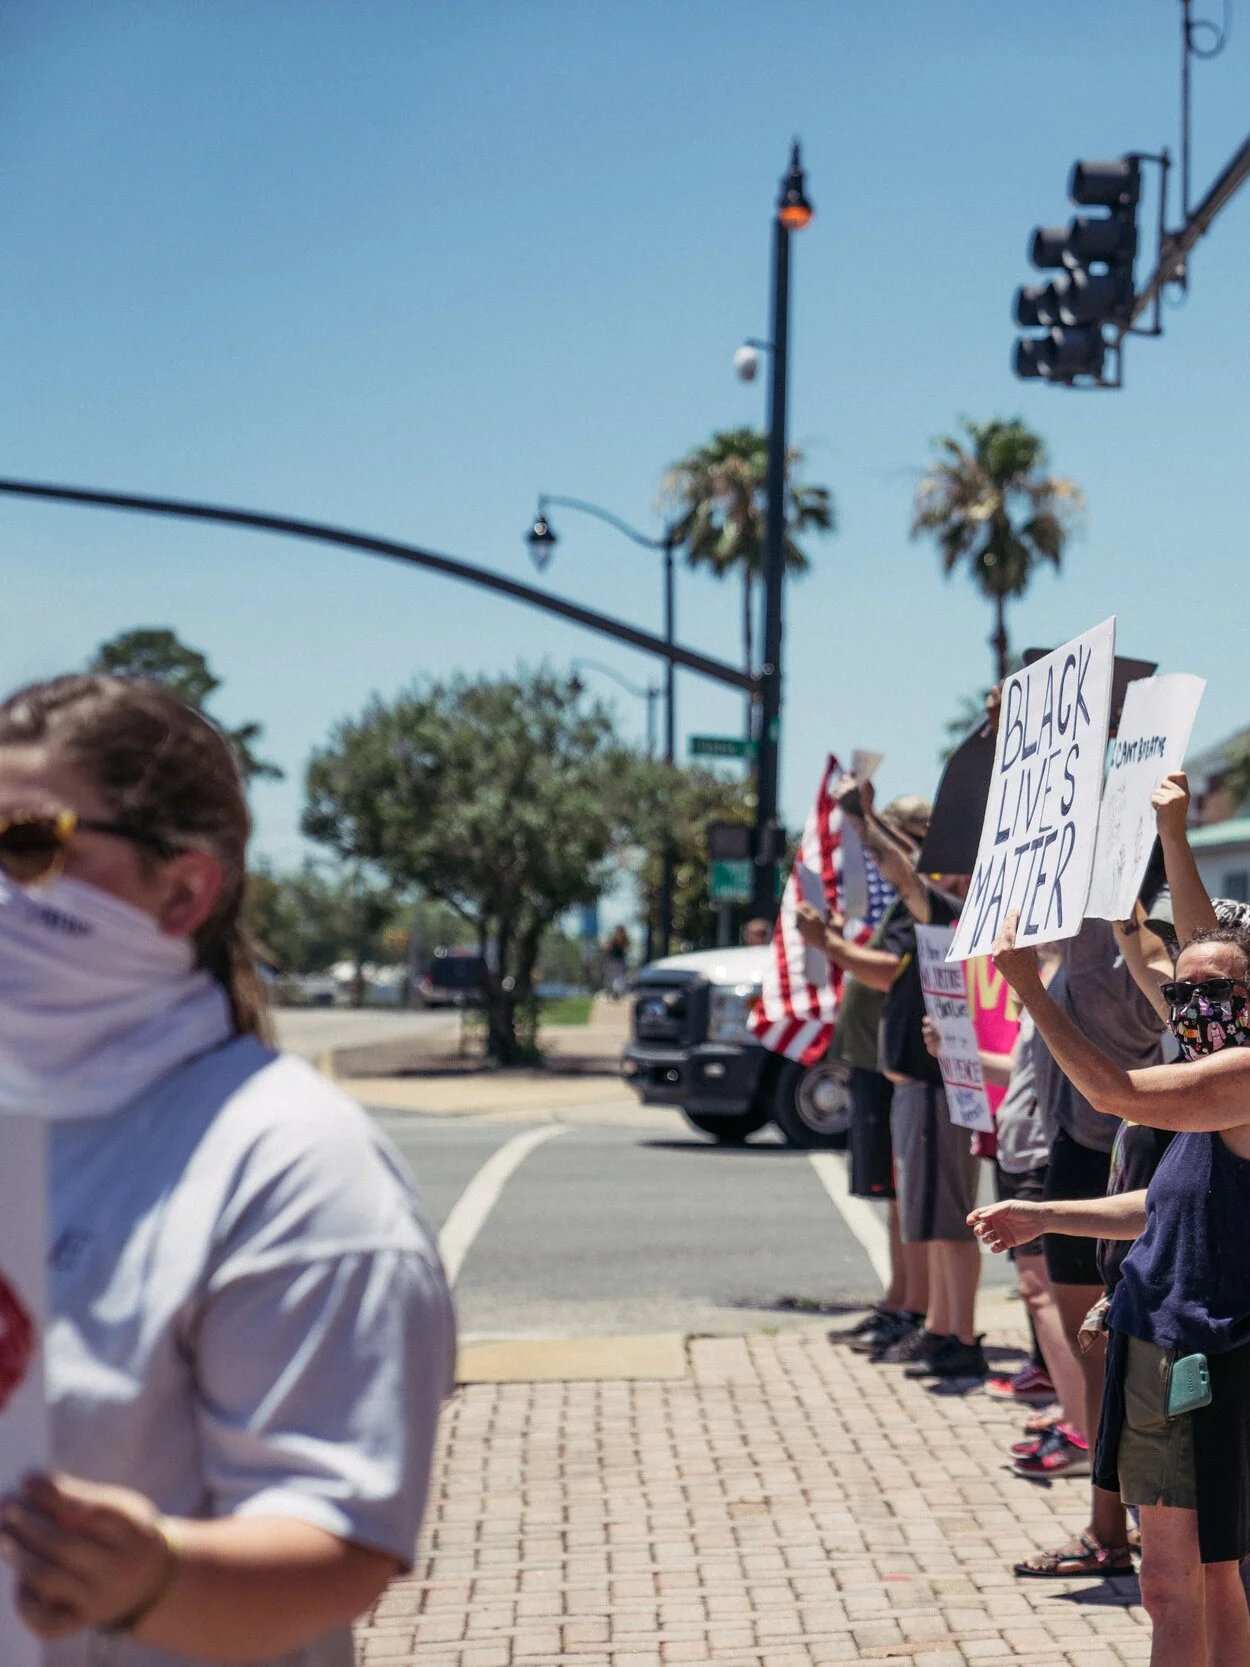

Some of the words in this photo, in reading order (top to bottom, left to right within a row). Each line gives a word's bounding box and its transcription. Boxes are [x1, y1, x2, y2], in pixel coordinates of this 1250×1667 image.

[1001, 644, 1092, 774] BLACK
[994, 743, 1080, 845] LIVES
[948, 821, 1076, 956] MATTER
